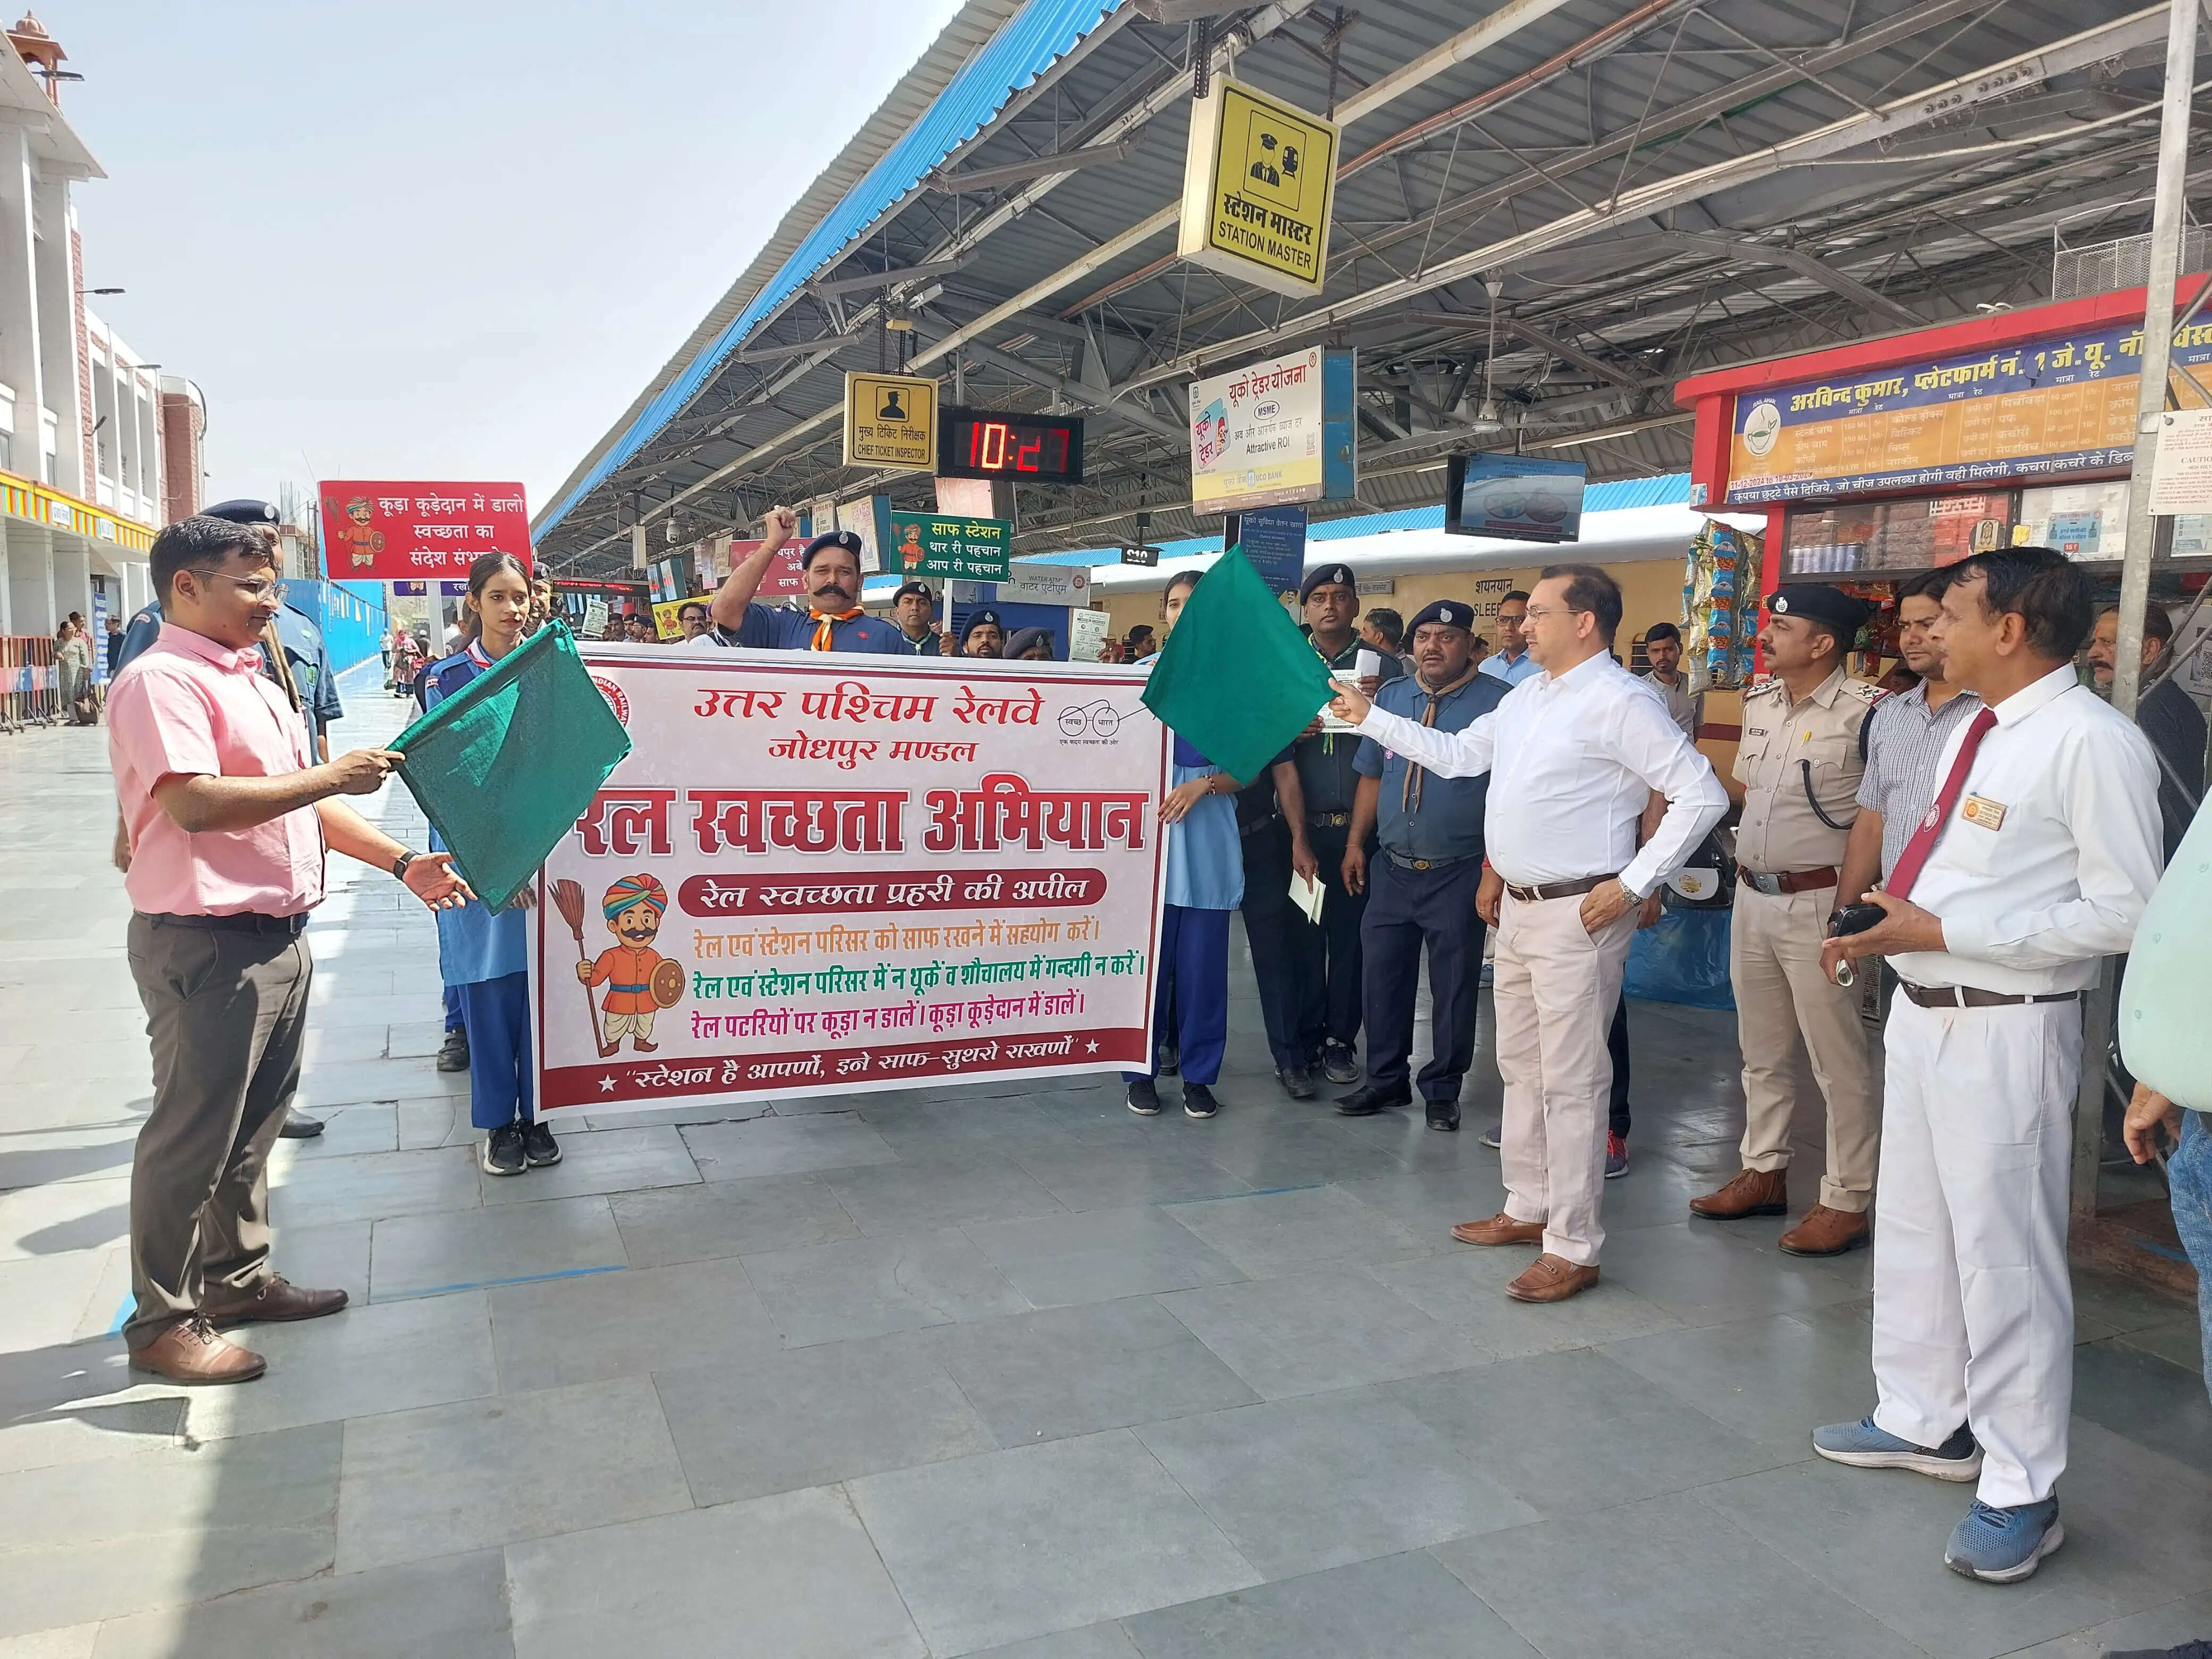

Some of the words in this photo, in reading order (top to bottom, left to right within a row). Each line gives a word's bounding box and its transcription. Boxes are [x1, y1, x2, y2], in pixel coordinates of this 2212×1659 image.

[1224, 190, 1269, 229] स्टेशन
[1270, 211, 1313, 246] मास्टर
[1219, 221, 1265, 253] STATION
[1268, 240, 1311, 270] MASTER
[1228, 373, 1250, 408] यूको
[1271, 363, 1307, 390] योजना
[1790, 386, 1853, 412] अरविन्द
[1914, 353, 1998, 390] प्लेटफार्म
[1948, 391, 1965, 400] मात्रा
[1973, 387, 1983, 396] रेट
[2055, 374, 2075, 383] मात्रा
[2088, 369, 2101, 379] रेट
[1258, 404, 1276, 417] MSME
[858, 425, 874, 443] मुख्य
[900, 426, 926, 442] निरीक्षक
[1195, 410, 1212, 441] यूको
[858, 444, 875, 456] CHIEF
[875, 446, 895, 458] TICKET
[895, 447, 926, 459] INSPECTOR
[1246, 439, 1276, 455] Attractive
[1277, 435, 1291, 448] ROI
[1268, 470, 1283, 480] BANK
[1730, 477, 1765, 491] 11-12-2024
[1733, 491, 1760, 504] कृपया
[1783, 484, 1799, 497] पैसे
[1836, 478, 1849, 491] जो
[1851, 476, 1874, 490] चीज
[1876, 474, 1918, 487] उपलब्ध
[1918, 468, 1944, 483] होगी
[1946, 467, 1967, 482] वही
[2015, 460, 2051, 474] कचरा
[2054, 453, 2087, 471] कचरे
[2089, 451, 2106, 466] के
[378, 497, 410, 517] कूड़ा
[415, 492, 467, 517] कूड़ेदान
[472, 492, 485, 512] में
[490, 493, 524, 513] डालो
[413, 524, 469, 539] स्वच्छता
[474, 525, 495, 539] का
[932, 522, 960, 537] साफ
[965, 520, 1002, 540] स्टेशन
[409, 546, 447, 569] संदेश
[929, 541, 948, 554] थार
[952, 540, 961, 555] री
[965, 543, 1002, 557] पहचान
[927, 559, 949, 572] आप
[953, 557, 963, 573] री
[966, 562, 1003, 575] पहचान
[777, 578, 799, 588] साफ
[1020, 582, 1038, 591] वाटर
[1041, 581, 1068, 596] एटीएम
[1476, 578, 1514, 594] शयनयान
[694, 688, 786, 719] उत्तर
[801, 681, 939, 723] पश्चिम
[952, 684, 1046, 726] रेलवे
[768, 730, 881, 770] जोधपुर
[889, 740, 980, 762] मण्डल
[685, 788, 910, 855] स्वच्छता
[923, 772, 1151, 853] अभियान
[700, 879, 749, 909] रेल
[759, 884, 878, 907] स्वच्छता
[886, 874, 955, 907] प्रहरी
[963, 873, 1005, 901] की
[1012, 872, 1091, 900] अपील
[693, 928, 724, 959] रेल
[727, 927, 759, 957] एवं
[759, 926, 811, 956] स्टेशन
[815, 924, 870, 954] परिसर
[873, 921, 899, 951] को
[902, 926, 940, 951] साफ
[943, 919, 990, 949] रखने
[988, 918, 1007, 947] में
[1007, 916, 1061, 945] सहयोग
[693, 967, 724, 1000] रेल
[727, 968, 759, 999] एवं
[758, 967, 811, 997] स्टेशन
[815, 964, 870, 995] परिसर
[872, 962, 893, 992] में
[892, 967, 907, 990] न
[910, 960, 946, 997] थूकें
[945, 964, 959, 987] व
[961, 957, 1026, 986] शौचालय
[1028, 953, 1047, 982] में
[1045, 951, 1093, 979] गन्दगी
[1094, 954, 1111, 977] न
[691, 1010, 723, 1040] रेल
[725, 1007, 794, 1038] पटरियों
[793, 1010, 818, 1034] पर
[822, 1008, 860, 1040] कूड़ा
[862, 1007, 879, 1030] न
[928, 1000, 965, 1034] कूड़ा
[968, 993, 1027, 1030] कूड़ेदान
[1028, 990, 1046, 1018] में
[720, 1060, 742, 1085] है
